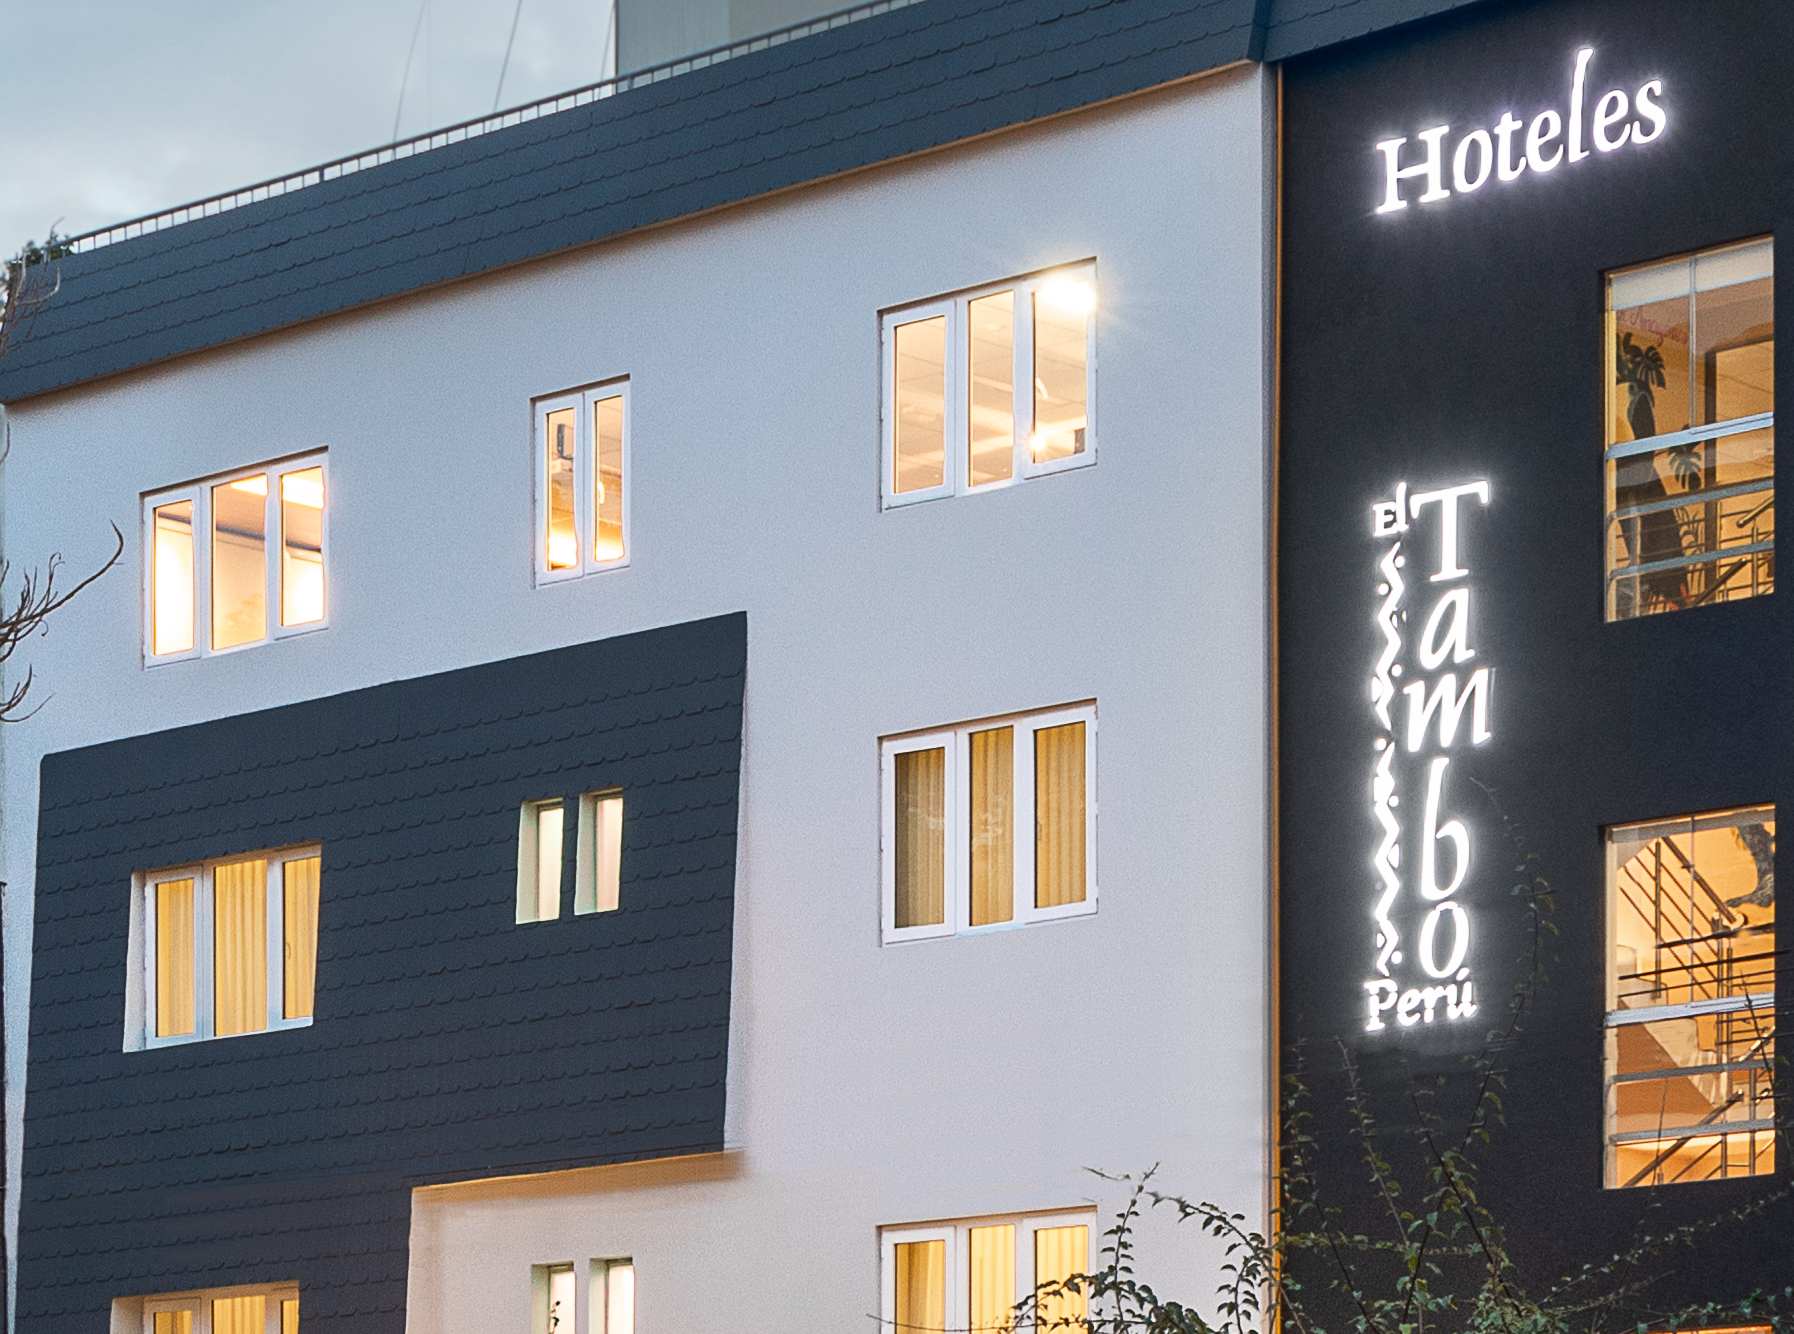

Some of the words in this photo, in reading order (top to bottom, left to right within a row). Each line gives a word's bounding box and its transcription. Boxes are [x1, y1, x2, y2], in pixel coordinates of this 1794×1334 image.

[1375, 47, 1667, 215] Hoteles
[1371, 481, 1410, 537] El
[1403, 480, 1491, 980] Tambo
[1363, 967, 1478, 1032] Perú
